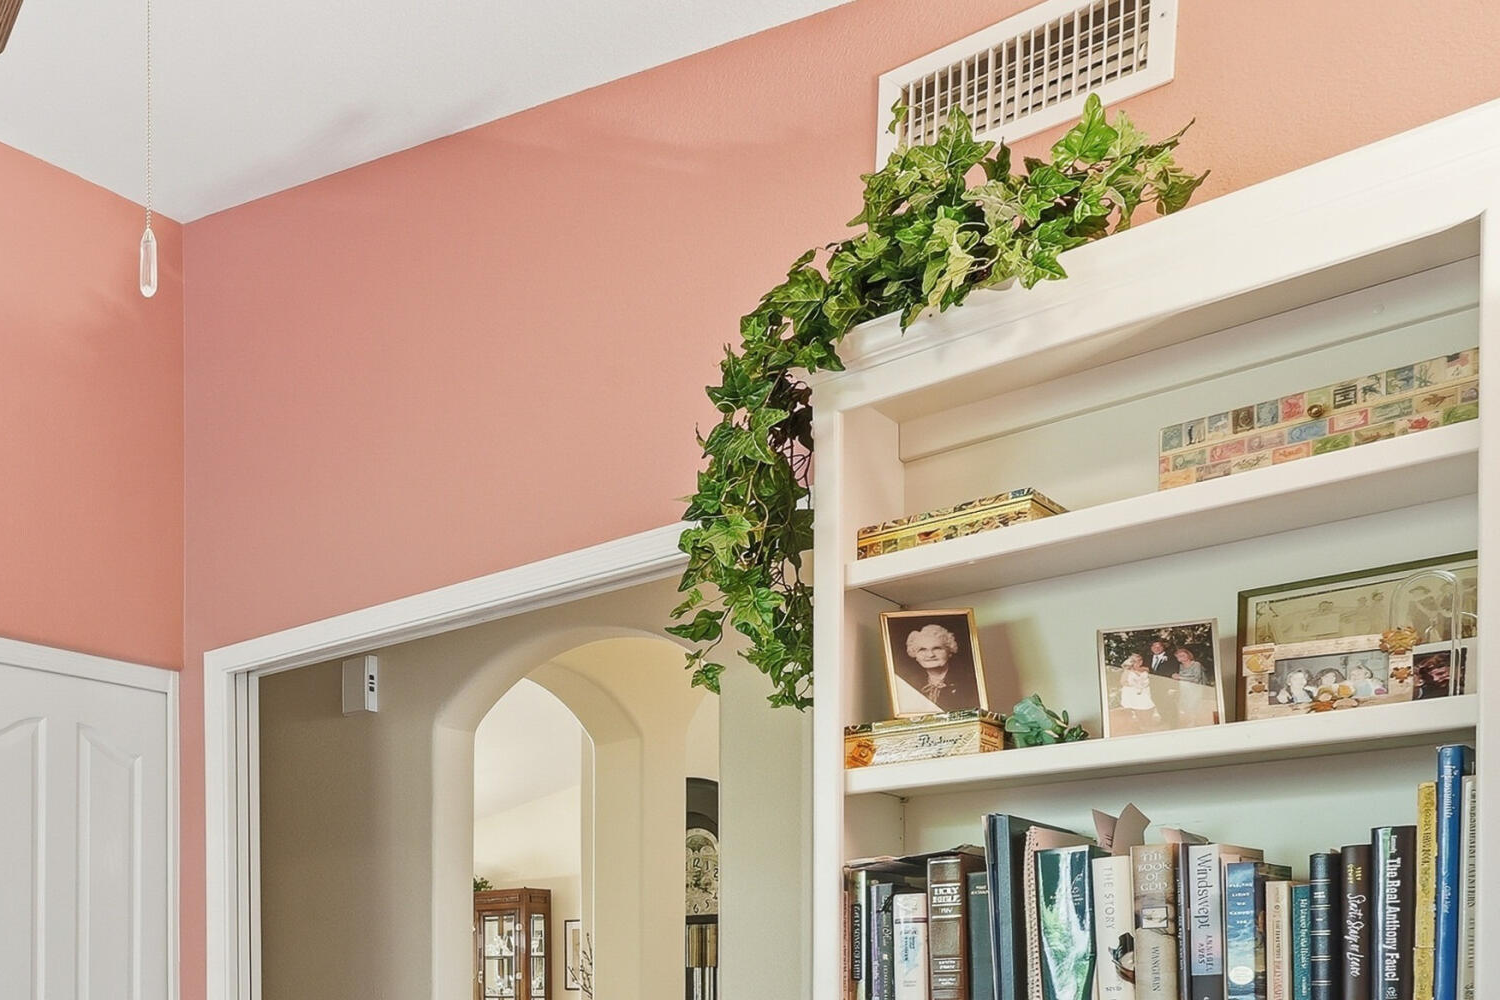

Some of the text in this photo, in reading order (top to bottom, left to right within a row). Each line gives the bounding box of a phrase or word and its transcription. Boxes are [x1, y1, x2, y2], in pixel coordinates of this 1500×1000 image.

[1386, 857, 1402, 878] The
[1103, 867, 1115, 930] THE STORY
[1141, 881, 1167, 891] GOD
[1193, 852, 1213, 929] Windswept
[1385, 880, 1401, 904] Real
[1383, 905, 1401, 950] Anthony
[1385, 952, 1400, 981] Fauci
